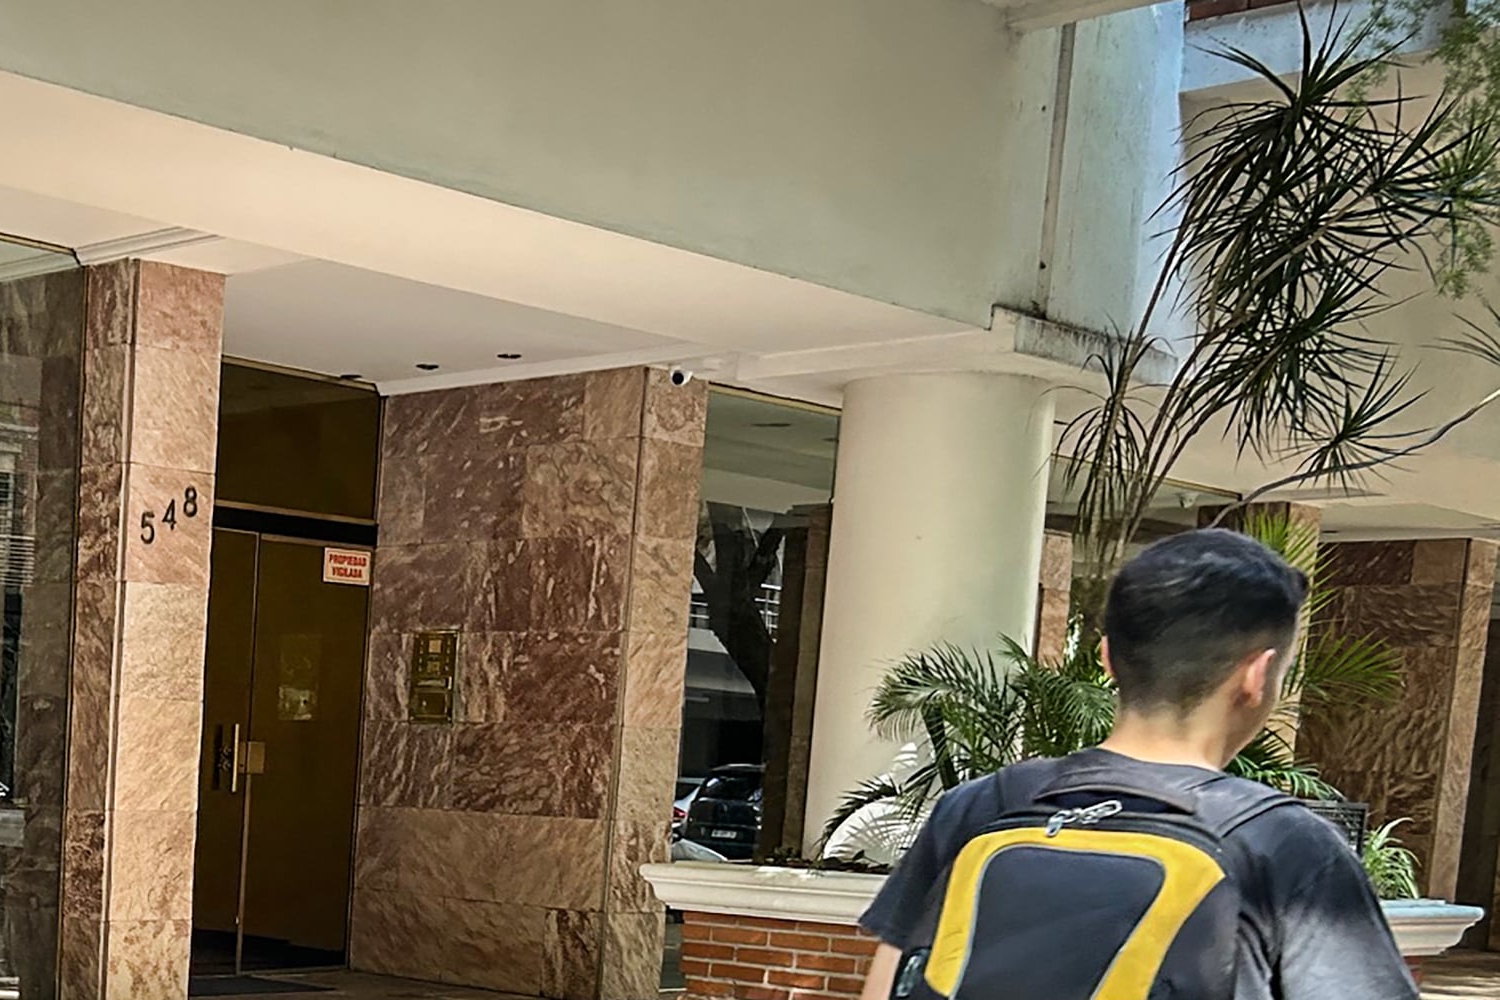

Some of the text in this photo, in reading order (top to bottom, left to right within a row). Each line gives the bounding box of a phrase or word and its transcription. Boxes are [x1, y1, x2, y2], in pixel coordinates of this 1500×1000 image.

[140, 486, 198, 544] 548
[329, 554, 367, 567] PROPIEDAD
[332, 567, 362, 578] VIGILADA
